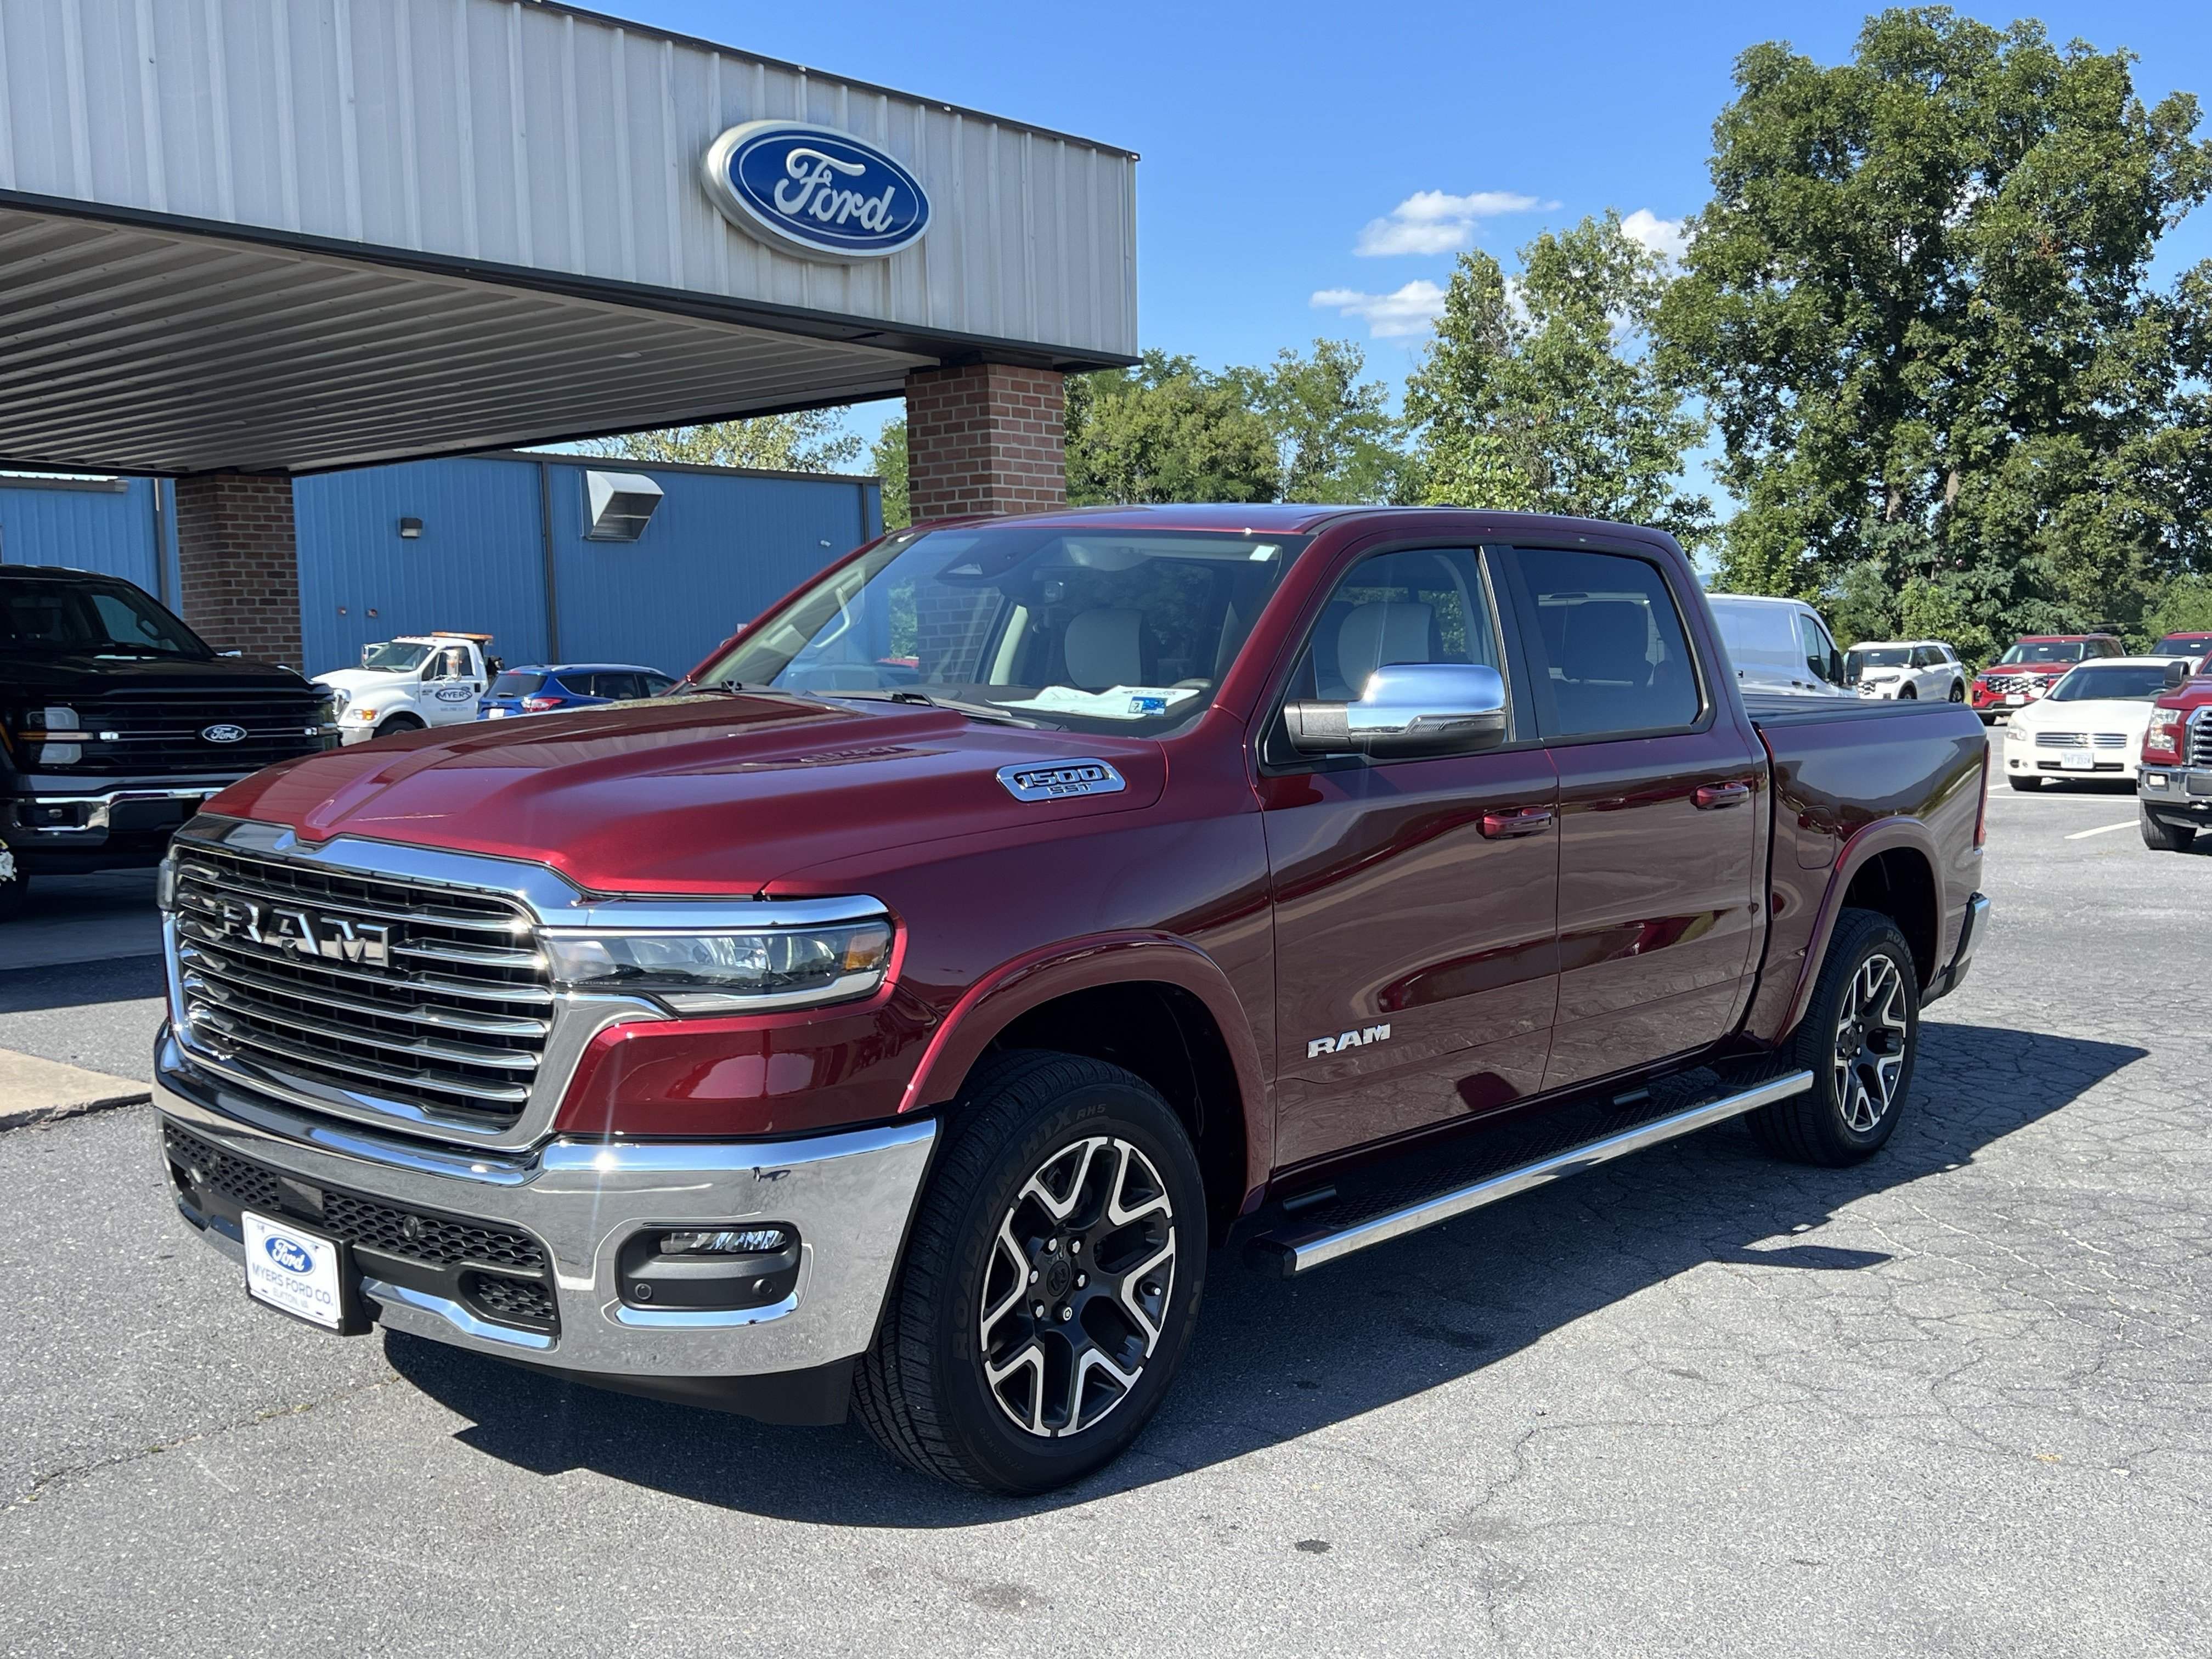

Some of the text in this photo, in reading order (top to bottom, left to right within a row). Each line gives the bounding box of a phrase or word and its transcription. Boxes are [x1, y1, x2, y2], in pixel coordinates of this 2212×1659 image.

[774, 148, 896, 233] Ford
[438, 690, 471, 698] MYERS
[210, 727, 239, 740] Ford
[1017, 767, 1103, 789] 1500
[215, 896, 390, 968] RAM
[1307, 1022, 1391, 1059] RAM
[1020, 1104, 1072, 1163] HTX
[272, 1239, 306, 1272] Ford
[252, 1262, 334, 1306] MYERS FORD CO.
